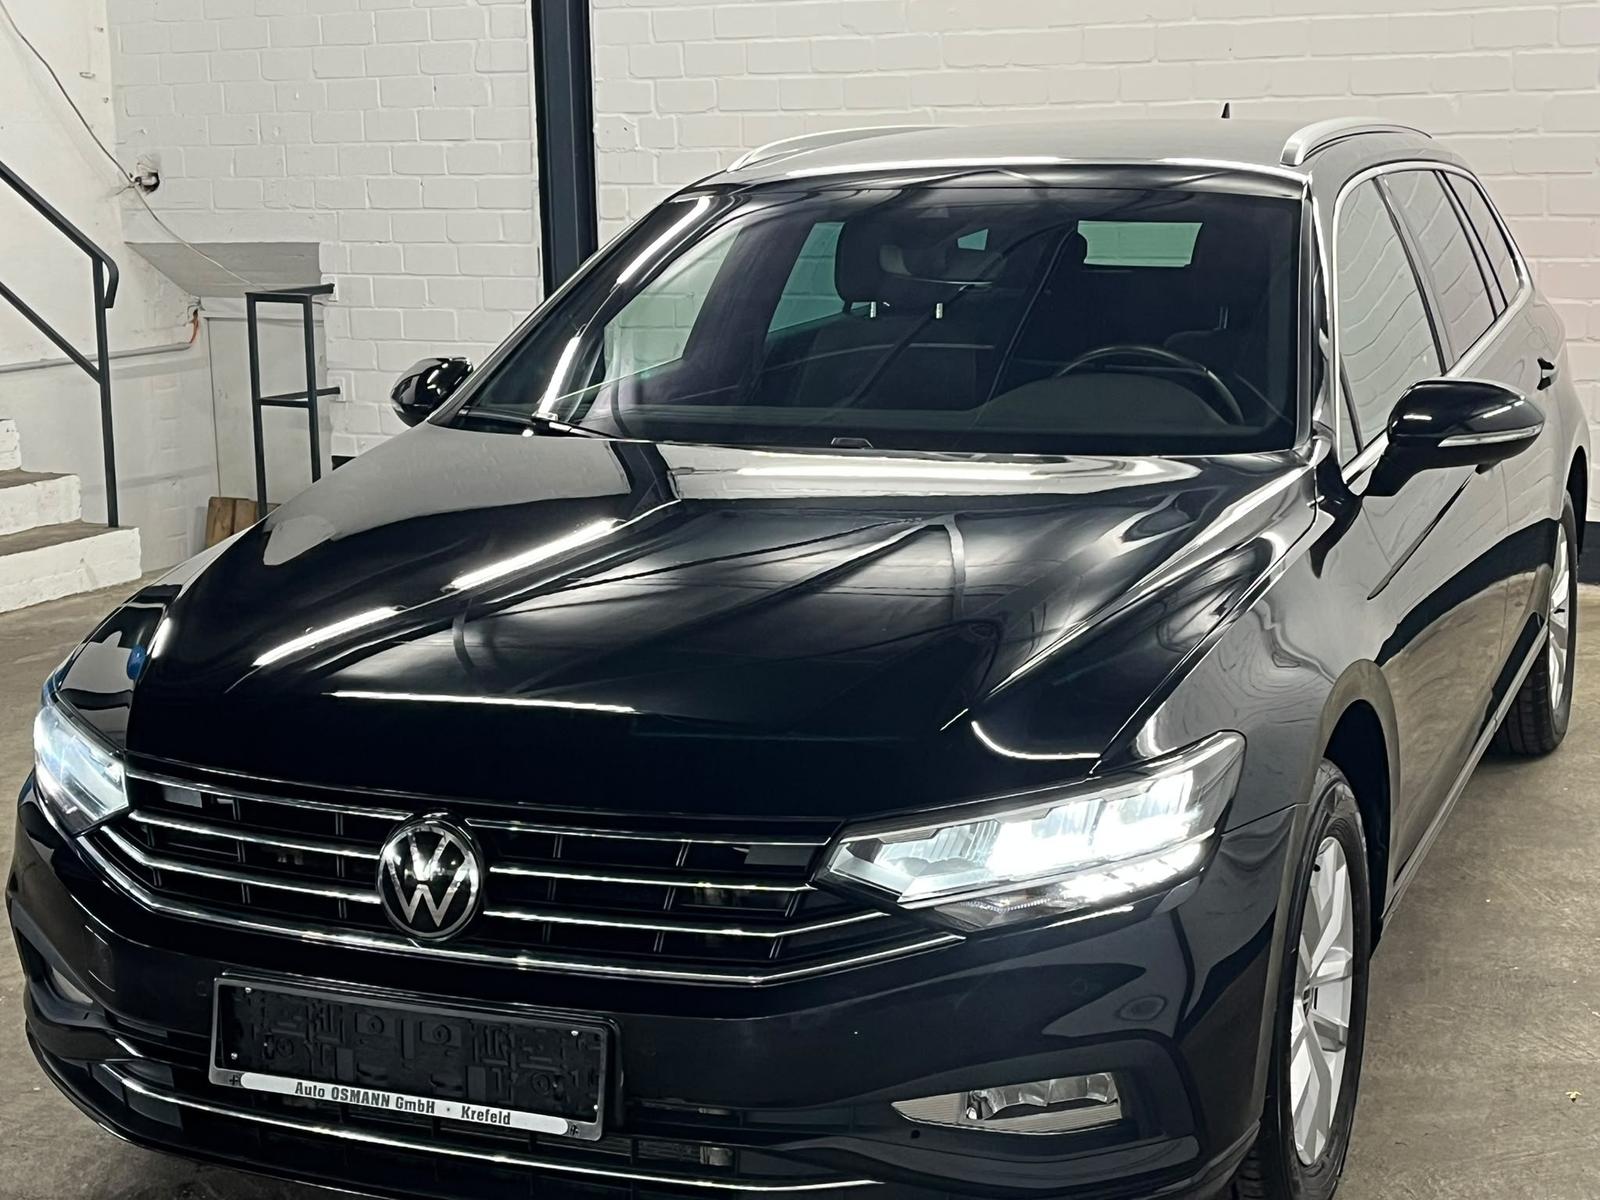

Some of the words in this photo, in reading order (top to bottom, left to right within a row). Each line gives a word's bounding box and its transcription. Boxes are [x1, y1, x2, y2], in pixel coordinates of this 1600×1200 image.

[295, 1081, 326, 1098] Auto
[331, 1086, 390, 1108] OSMANN
[395, 1096, 436, 1114] GmbH
[461, 1105, 511, 1125] Krefeld
